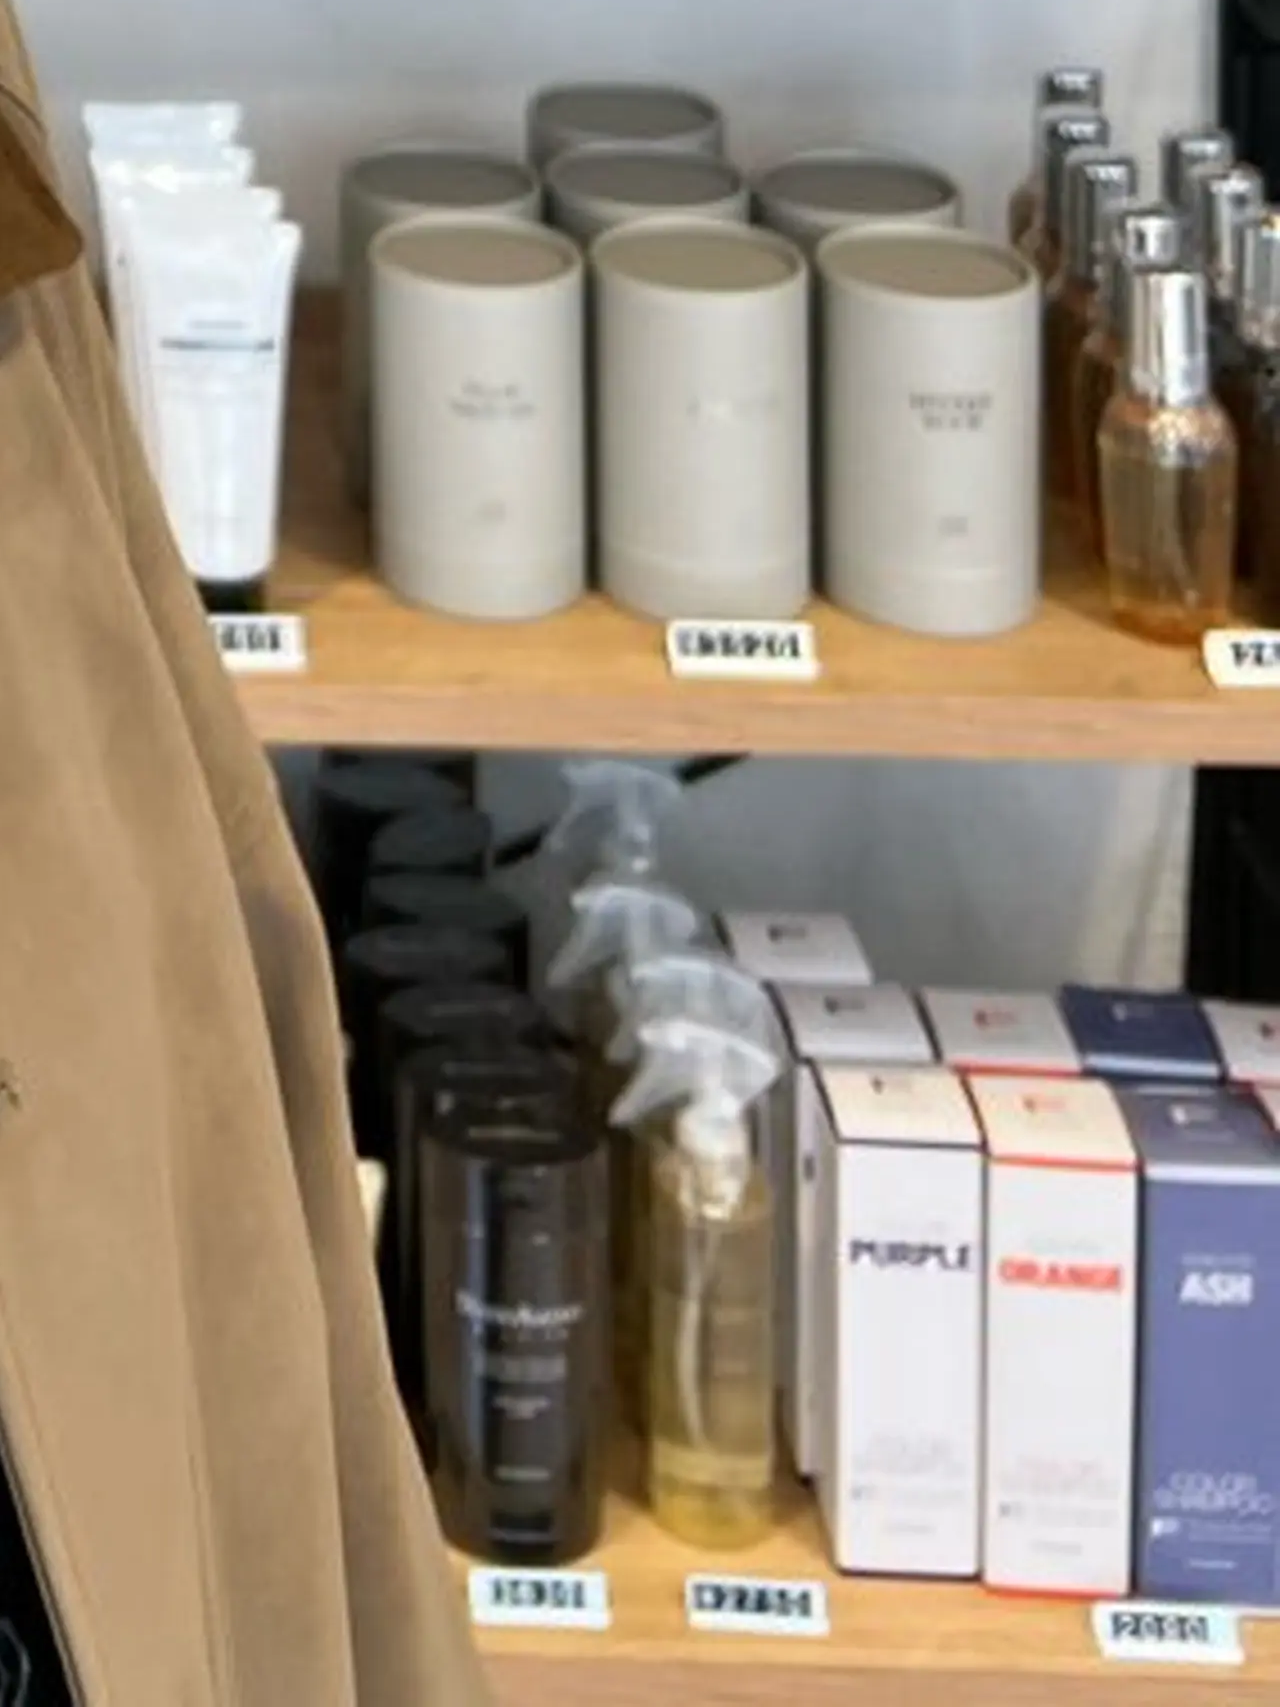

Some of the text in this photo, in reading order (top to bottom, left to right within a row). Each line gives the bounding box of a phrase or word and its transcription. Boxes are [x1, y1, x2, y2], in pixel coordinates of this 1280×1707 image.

[849, 1238, 971, 1271] PURPLE
[999, 1257, 1123, 1293] ORANGE
[1178, 1271, 1255, 1306] ASH
